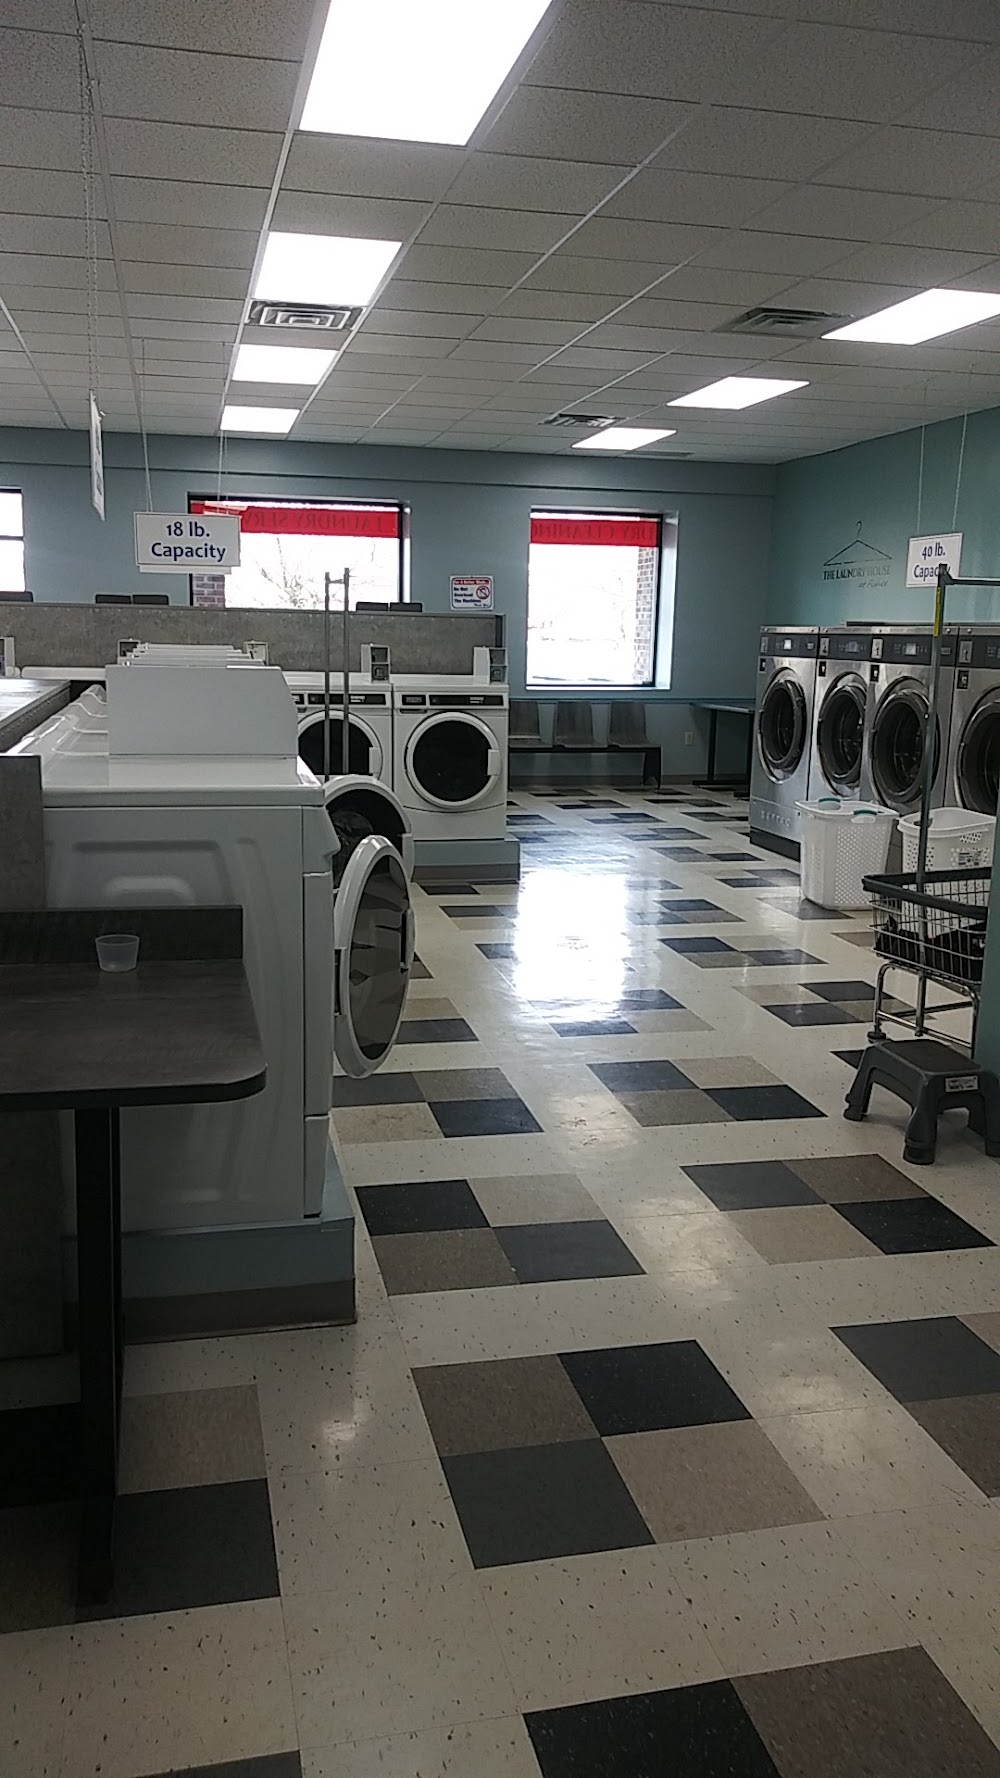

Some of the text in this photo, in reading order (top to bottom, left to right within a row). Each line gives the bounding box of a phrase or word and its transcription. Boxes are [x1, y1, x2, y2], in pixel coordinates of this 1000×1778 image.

[166, 521, 211, 537] 18 lb.
[151, 542, 226, 563] Capacity
[921, 542, 946, 561] 40 lb.
[823, 569, 836, 581] THE
